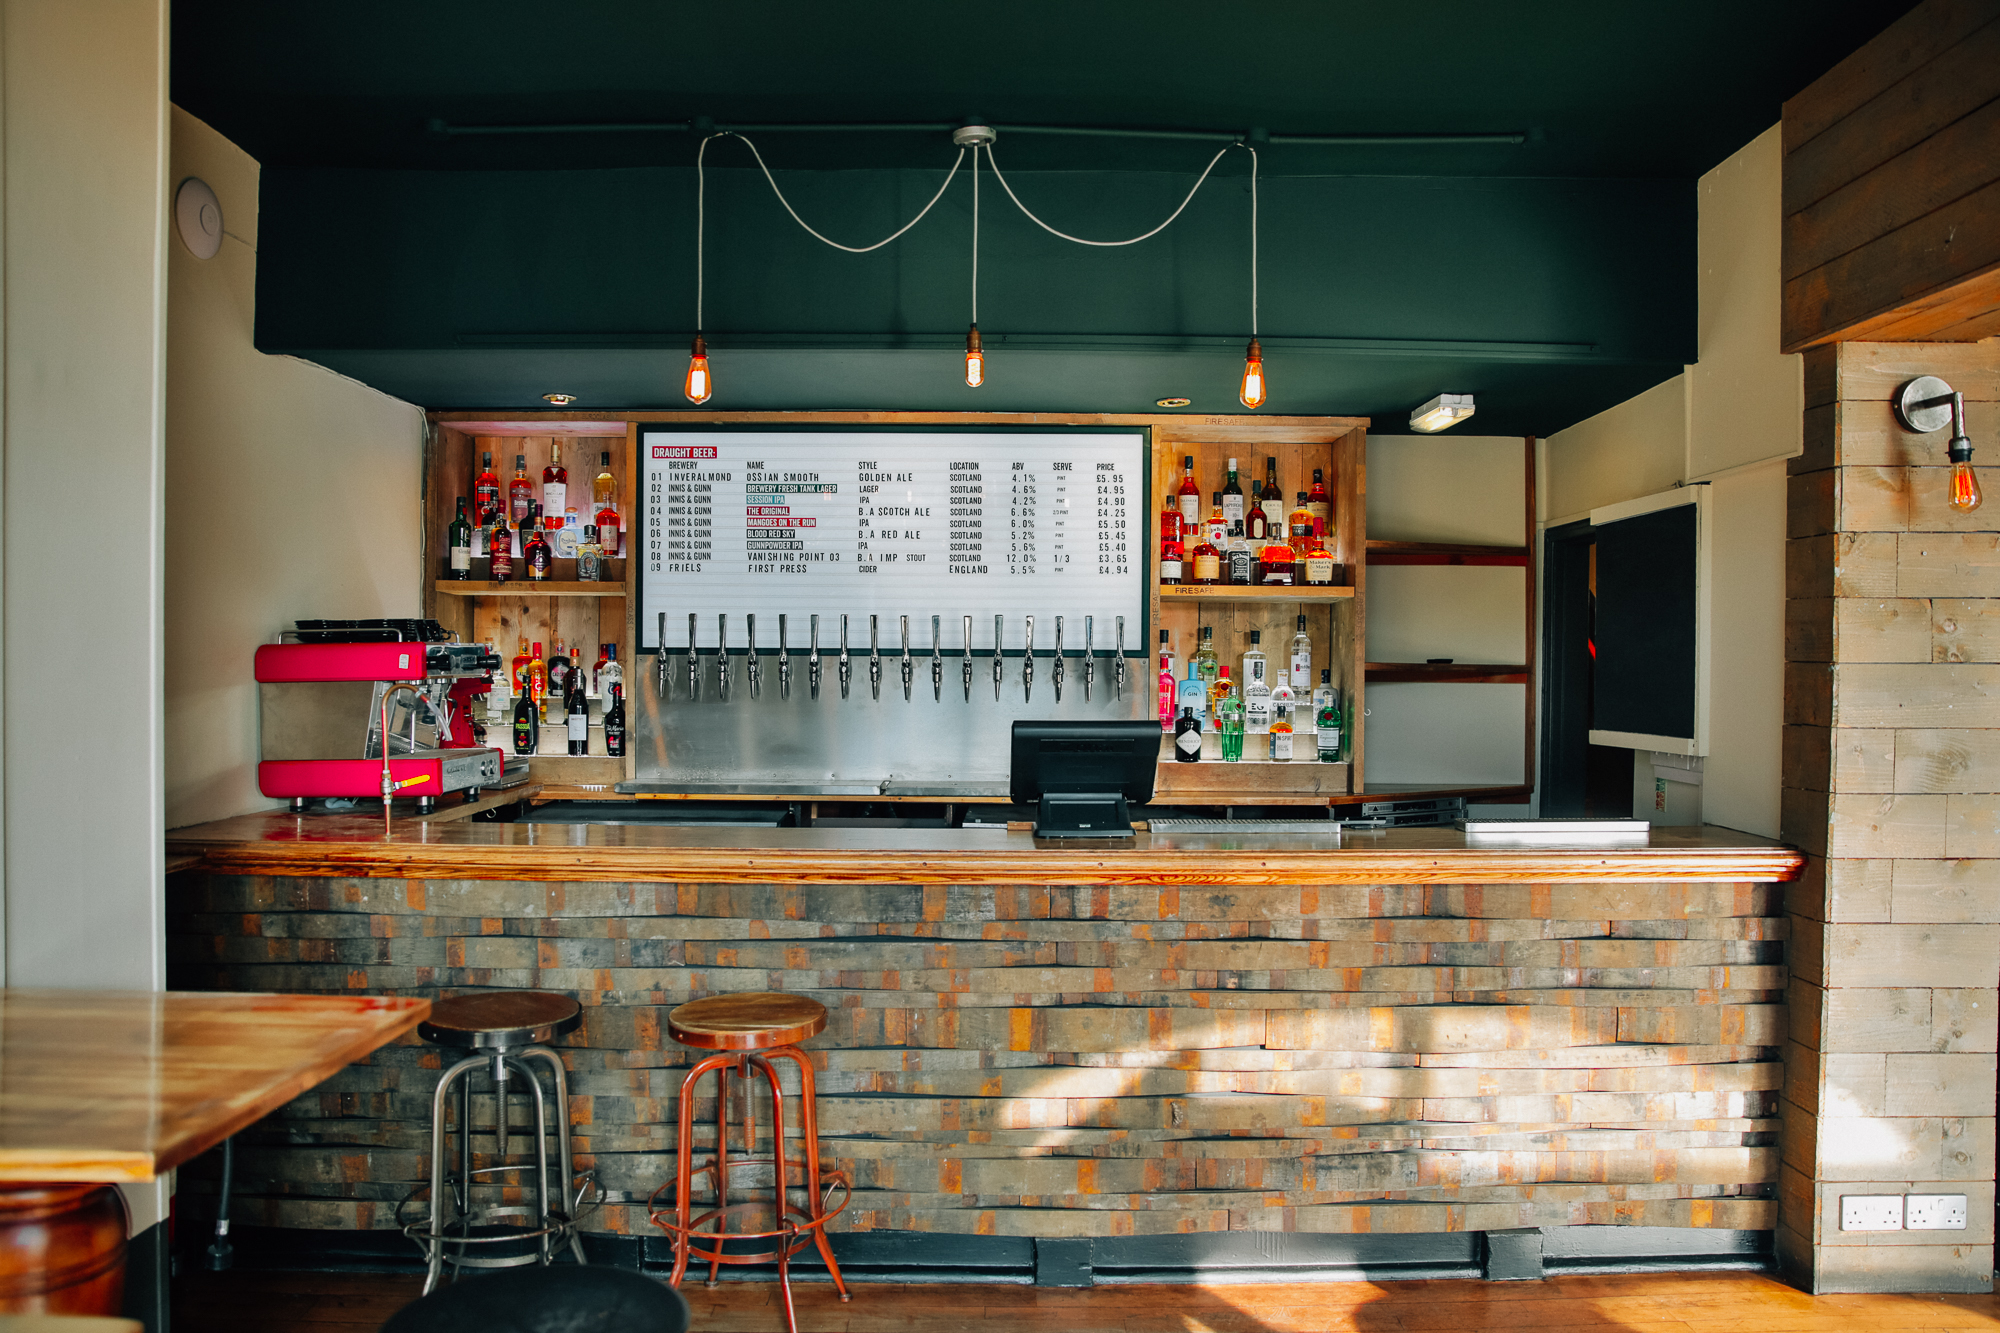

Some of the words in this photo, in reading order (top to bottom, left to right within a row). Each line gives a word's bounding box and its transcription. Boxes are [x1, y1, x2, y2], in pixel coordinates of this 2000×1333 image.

[654, 448, 691, 457] DRAUGHT
[693, 448, 715, 457] BEER:
[669, 461, 697, 469] BREWERY
[747, 461, 764, 469] NAME
[950, 462, 979, 470] LOCATION
[1012, 462, 1024, 470] ABV
[1097, 463, 1114, 471] PRICE
[652, 473, 661, 481] 01
[670, 473, 731, 481] INVERALMOND
[747, 473, 778, 481] OSSIAN
[784, 473, 818, 481] SMOOTH
[859, 473, 891, 481] GOLDEN
[897, 473, 912, 482] ALE
[1012, 474, 1035, 482] 4.1%
[1097, 475, 1123, 483] £5.95
[652, 484, 661, 492] 02
[669, 484, 685, 492] INNIS
[687, 484, 692, 492] &
[694, 484, 711, 492] GUNN
[860, 485, 878, 493] LAGER
[1098, 486, 1124, 494] £4.95
[651, 495, 660, 503] 03
[669, 495, 685, 503] INNIS
[687, 495, 692, 503] &
[1013, 497, 1036, 505] 4.2%
[651, 507, 661, 515] 04
[694, 507, 711, 515] GUNN
[878, 507, 909, 516] SCOTCH
[915, 508, 930, 516] ALE
[950, 508, 982, 516] SCOTLAND
[1011, 508, 1035, 516] 6.6%
[1098, 509, 1125, 517] £4.25
[650, 518, 660, 526] 05
[669, 518, 685, 526] INNIS
[687, 518, 692, 526] &
[694, 518, 711, 526] GUNN
[1011, 519, 1034, 528] 6.0%
[1099, 520, 1125, 528] £5.50
[651, 529, 660, 537] 06
[882, 530, 897, 539] RED
[905, 531, 920, 539] ALE
[1012, 532, 1034, 540] 5.2%
[1099, 532, 1125, 540] £5.45
[651, 541, 661, 549] 07
[669, 541, 685, 549] INNIS
[687, 541, 692, 549] &
[694, 541, 711, 549] GUNN
[950, 543, 981, 551] SCOTLAND
[1012, 543, 1035, 551] 5.6%
[1100, 543, 1125, 551] £5.40
[651, 552, 661, 560] 08
[669, 552, 685, 560] INNIS
[687, 552, 692, 560] &
[694, 552, 711, 560] GUNN
[748, 553, 794, 561] VANISHING
[800, 553, 824, 561] POINT
[830, 553, 839, 561] 03
[881, 554, 897, 562] IMP
[950, 554, 981, 562] SCOTLAND
[1007, 554, 1036, 562] 12.0%
[1099, 555, 1126, 563] £3.65
[651, 563, 660, 571] 09
[670, 563, 701, 572] FRIELS
[749, 564, 774, 573] FIRST
[780, 564, 806, 573] PRESS
[950, 565, 987, 574] ENGLAND
[1011, 566, 1035, 574] 5.5%
[1100, 566, 1127, 574] £4.94
